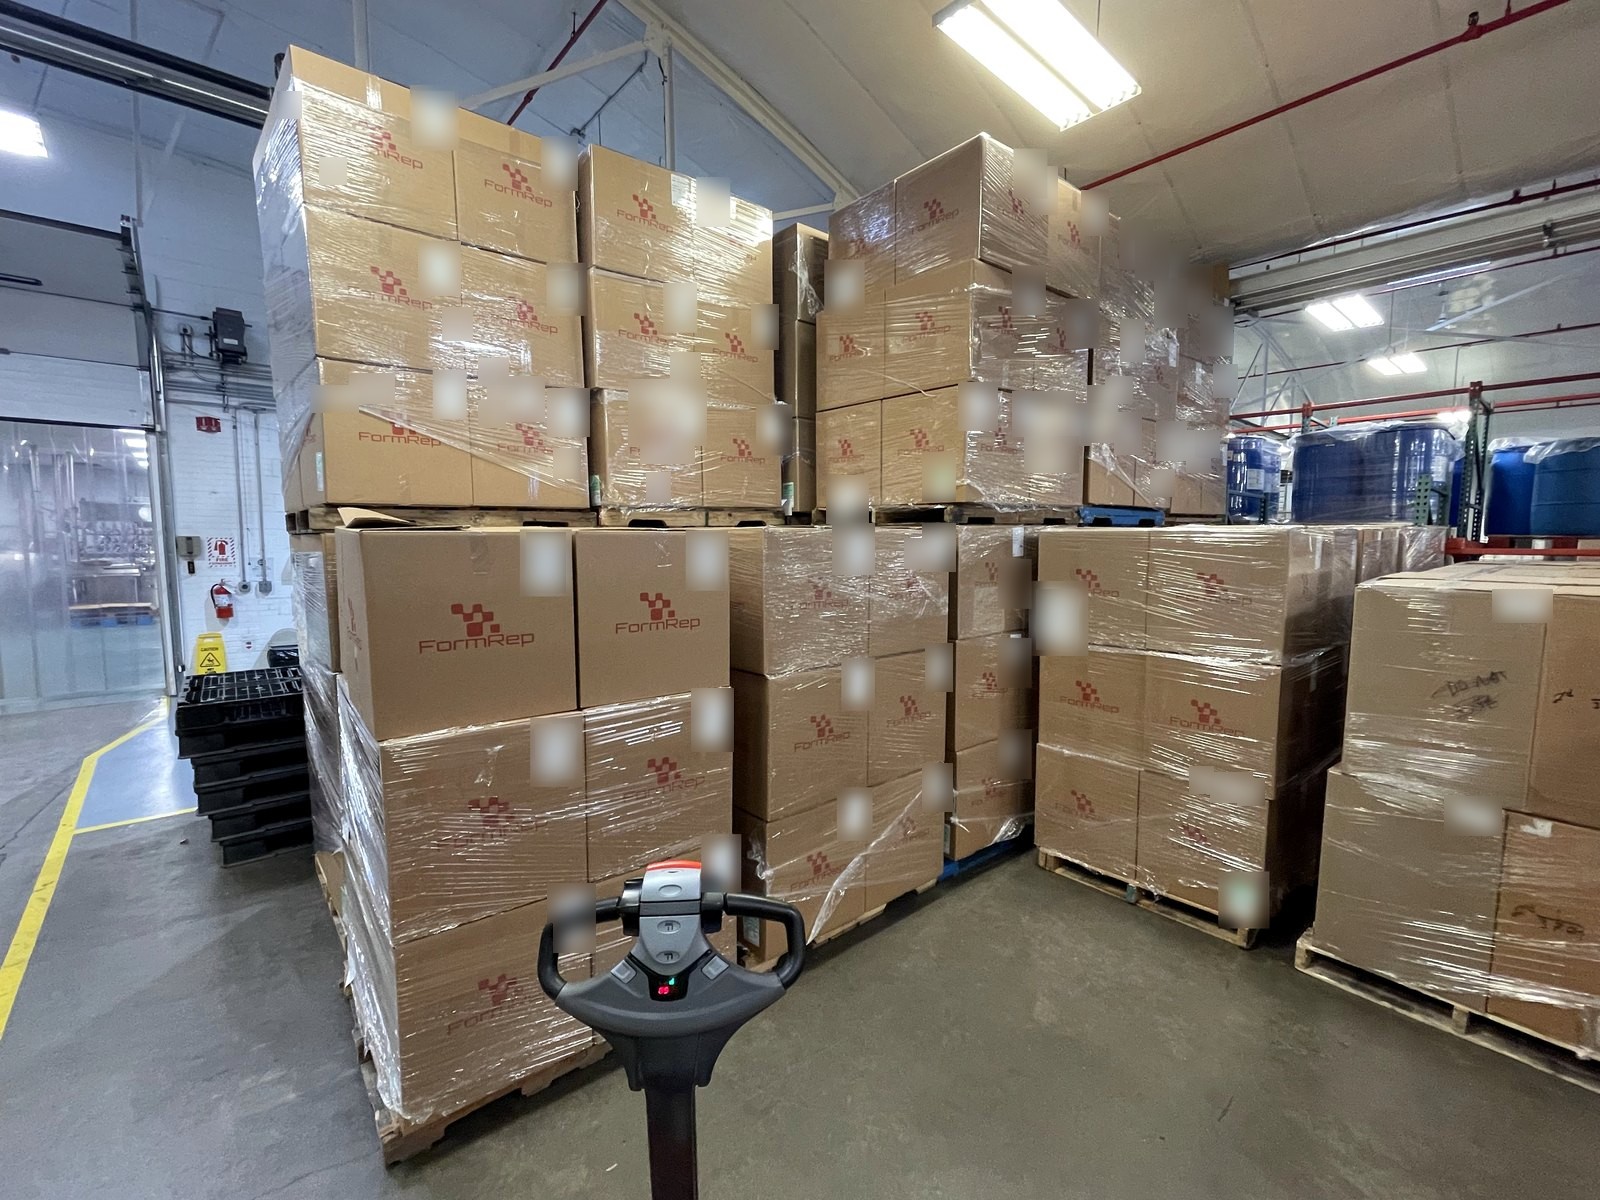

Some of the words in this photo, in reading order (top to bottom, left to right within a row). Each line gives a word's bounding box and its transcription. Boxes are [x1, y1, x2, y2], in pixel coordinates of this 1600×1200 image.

[484, 178, 553, 209] FormRep
[617, 209, 675, 233] FormRep
[617, 329, 668, 346] FormRe
[358, 432, 442, 449] FormRep
[720, 455, 765, 465] FormRep
[791, 598, 849, 611] ormRep
[615, 617, 701, 635] FormRep
[419, 633, 534, 655] FormRep
[1059, 696, 1120, 714] FormRep
[1170, 716, 1245, 736] FormRep
[794, 731, 851, 752] FormRep
[622, 776, 706, 803] FormRep
